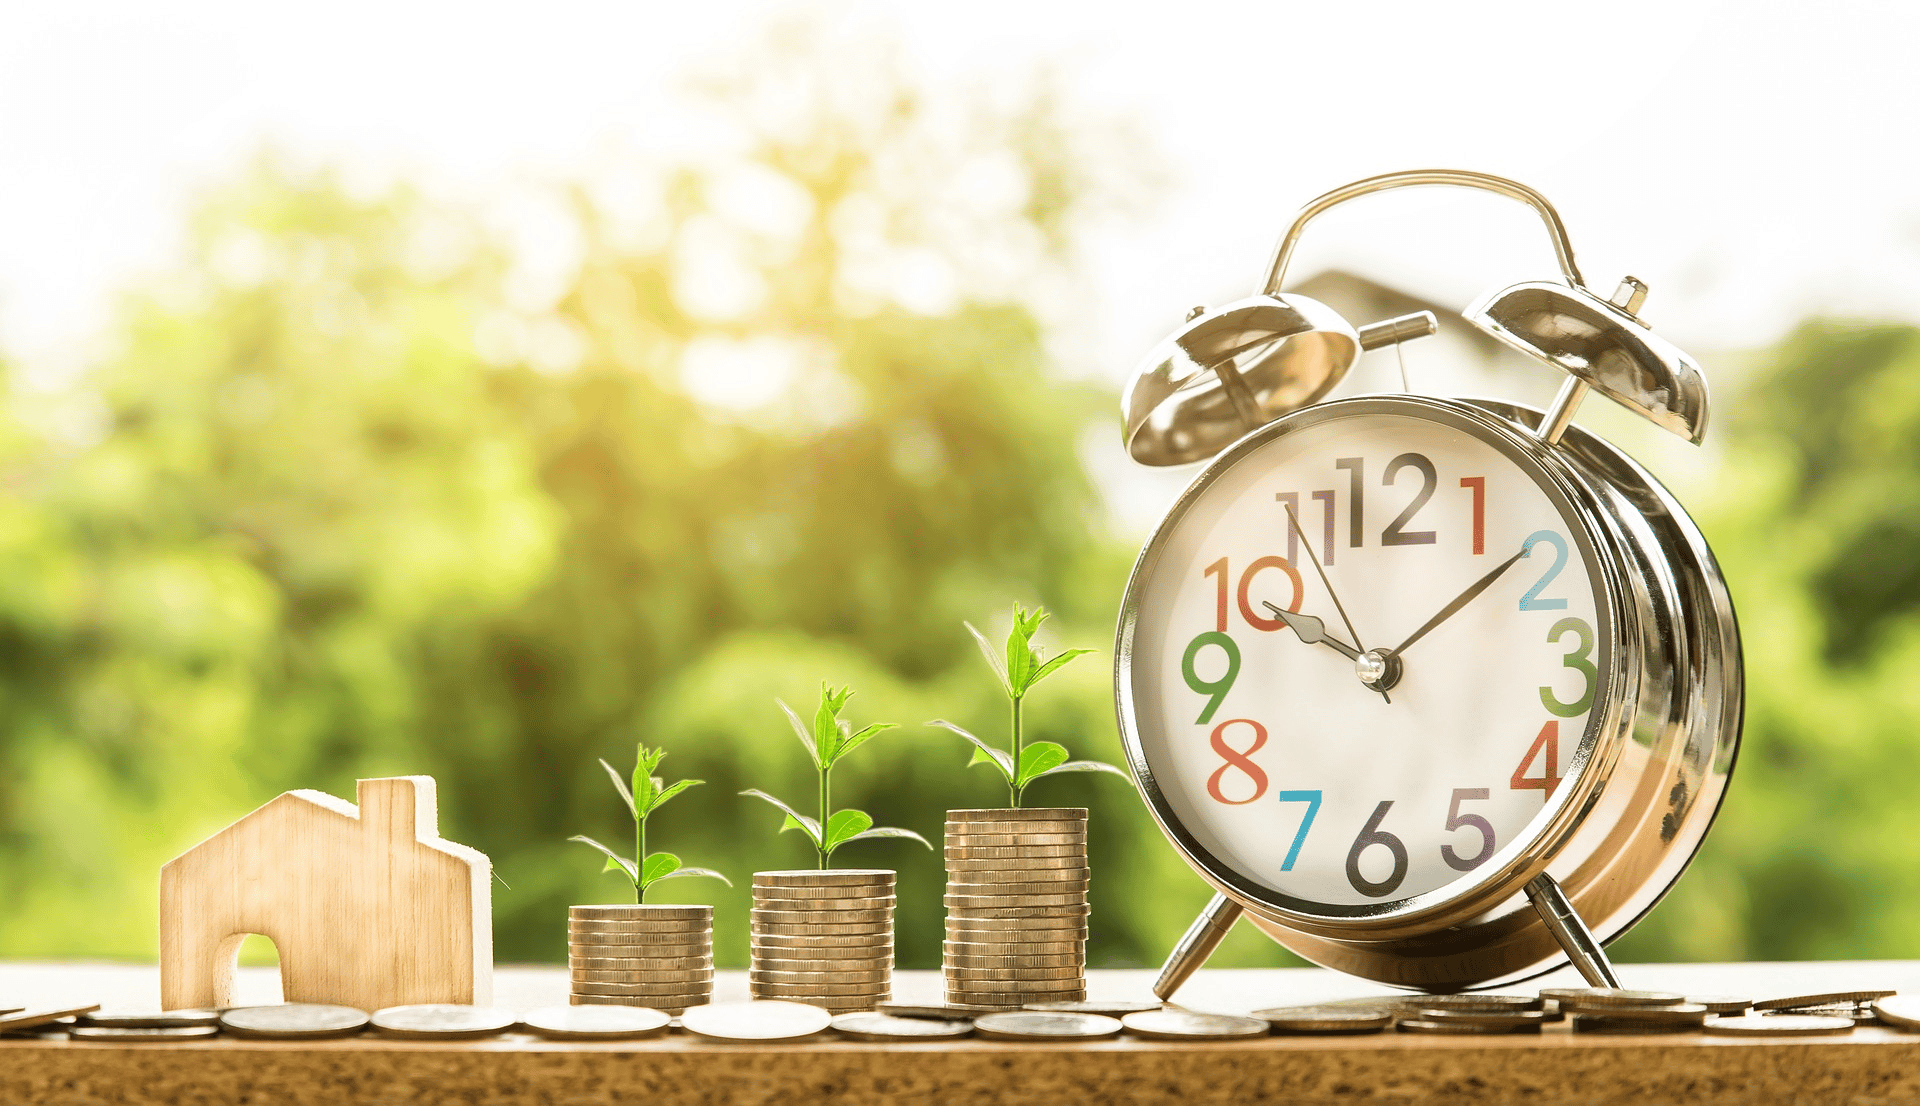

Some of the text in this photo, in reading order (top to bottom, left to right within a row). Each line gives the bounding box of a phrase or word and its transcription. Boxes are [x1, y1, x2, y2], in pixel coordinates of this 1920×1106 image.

[1275, 490, 1336, 568] 11
[1336, 452, 1438, 548] 12
[1460, 476, 1485, 555] 1
[1203, 555, 1304, 632] 10
[1518, 529, 1569, 611] 2
[1181, 631, 1241, 725] 9
[1538, 617, 1598, 718] 3
[1207, 718, 1268, 805] 8
[1510, 720, 1563, 803] 4
[1279, 790, 1322, 871] 7
[1345, 800, 1409, 898] 6
[1440, 787, 1496, 871] 5
